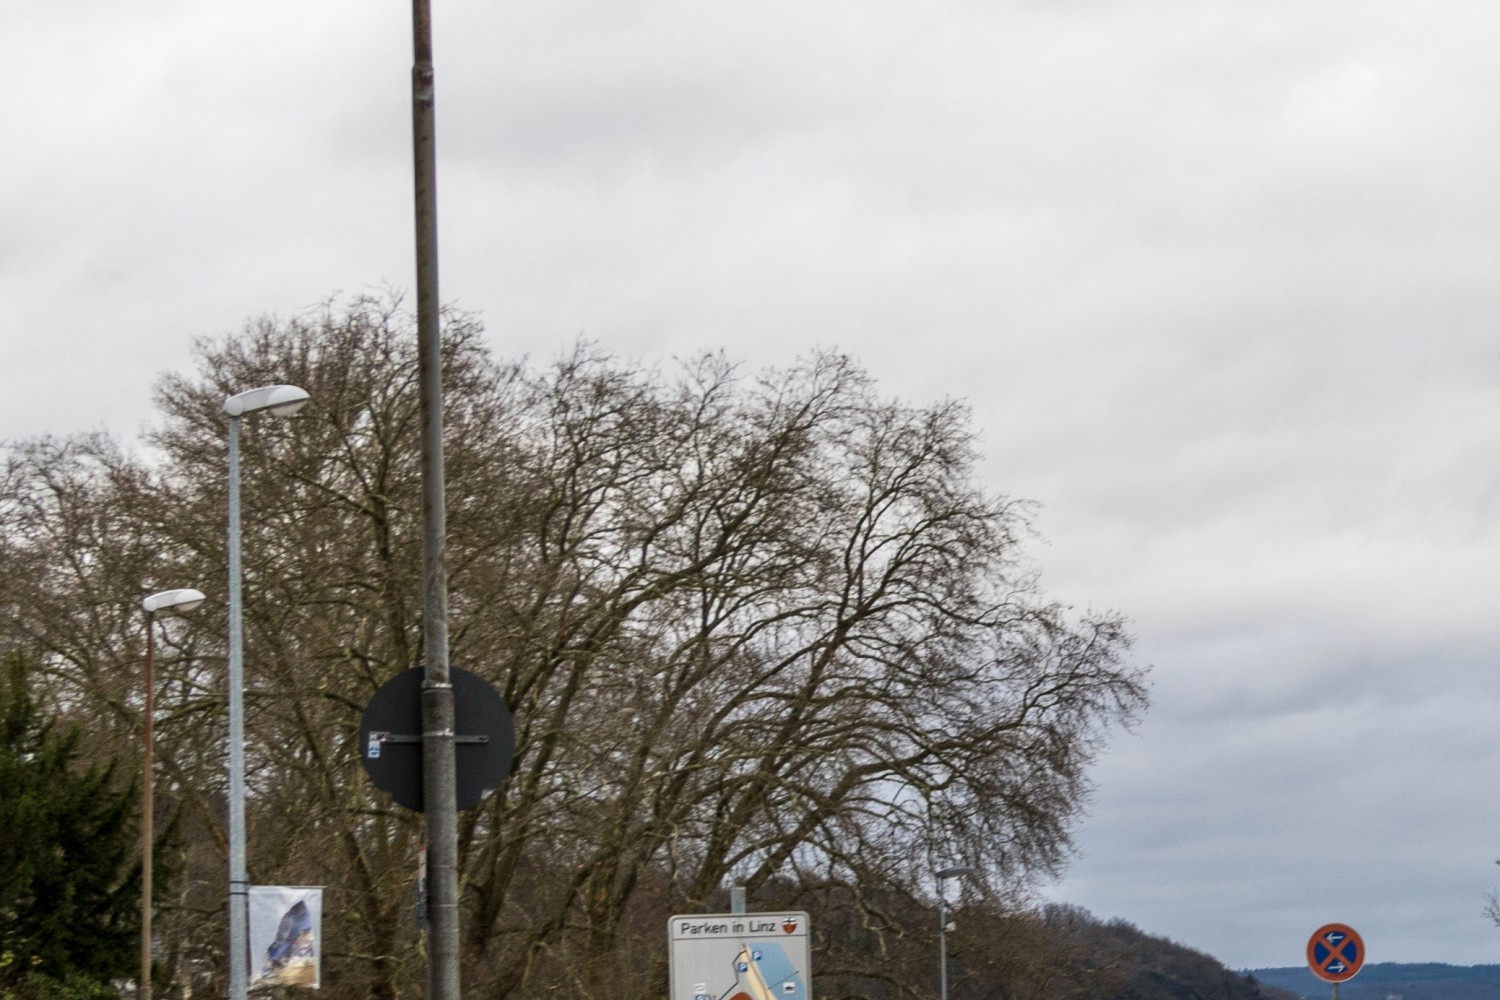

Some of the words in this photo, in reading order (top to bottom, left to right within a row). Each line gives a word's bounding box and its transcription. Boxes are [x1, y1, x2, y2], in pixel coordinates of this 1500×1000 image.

[681, 922, 728, 934] Parken
[732, 921, 744, 933] in
[749, 920, 776, 933] Linz
